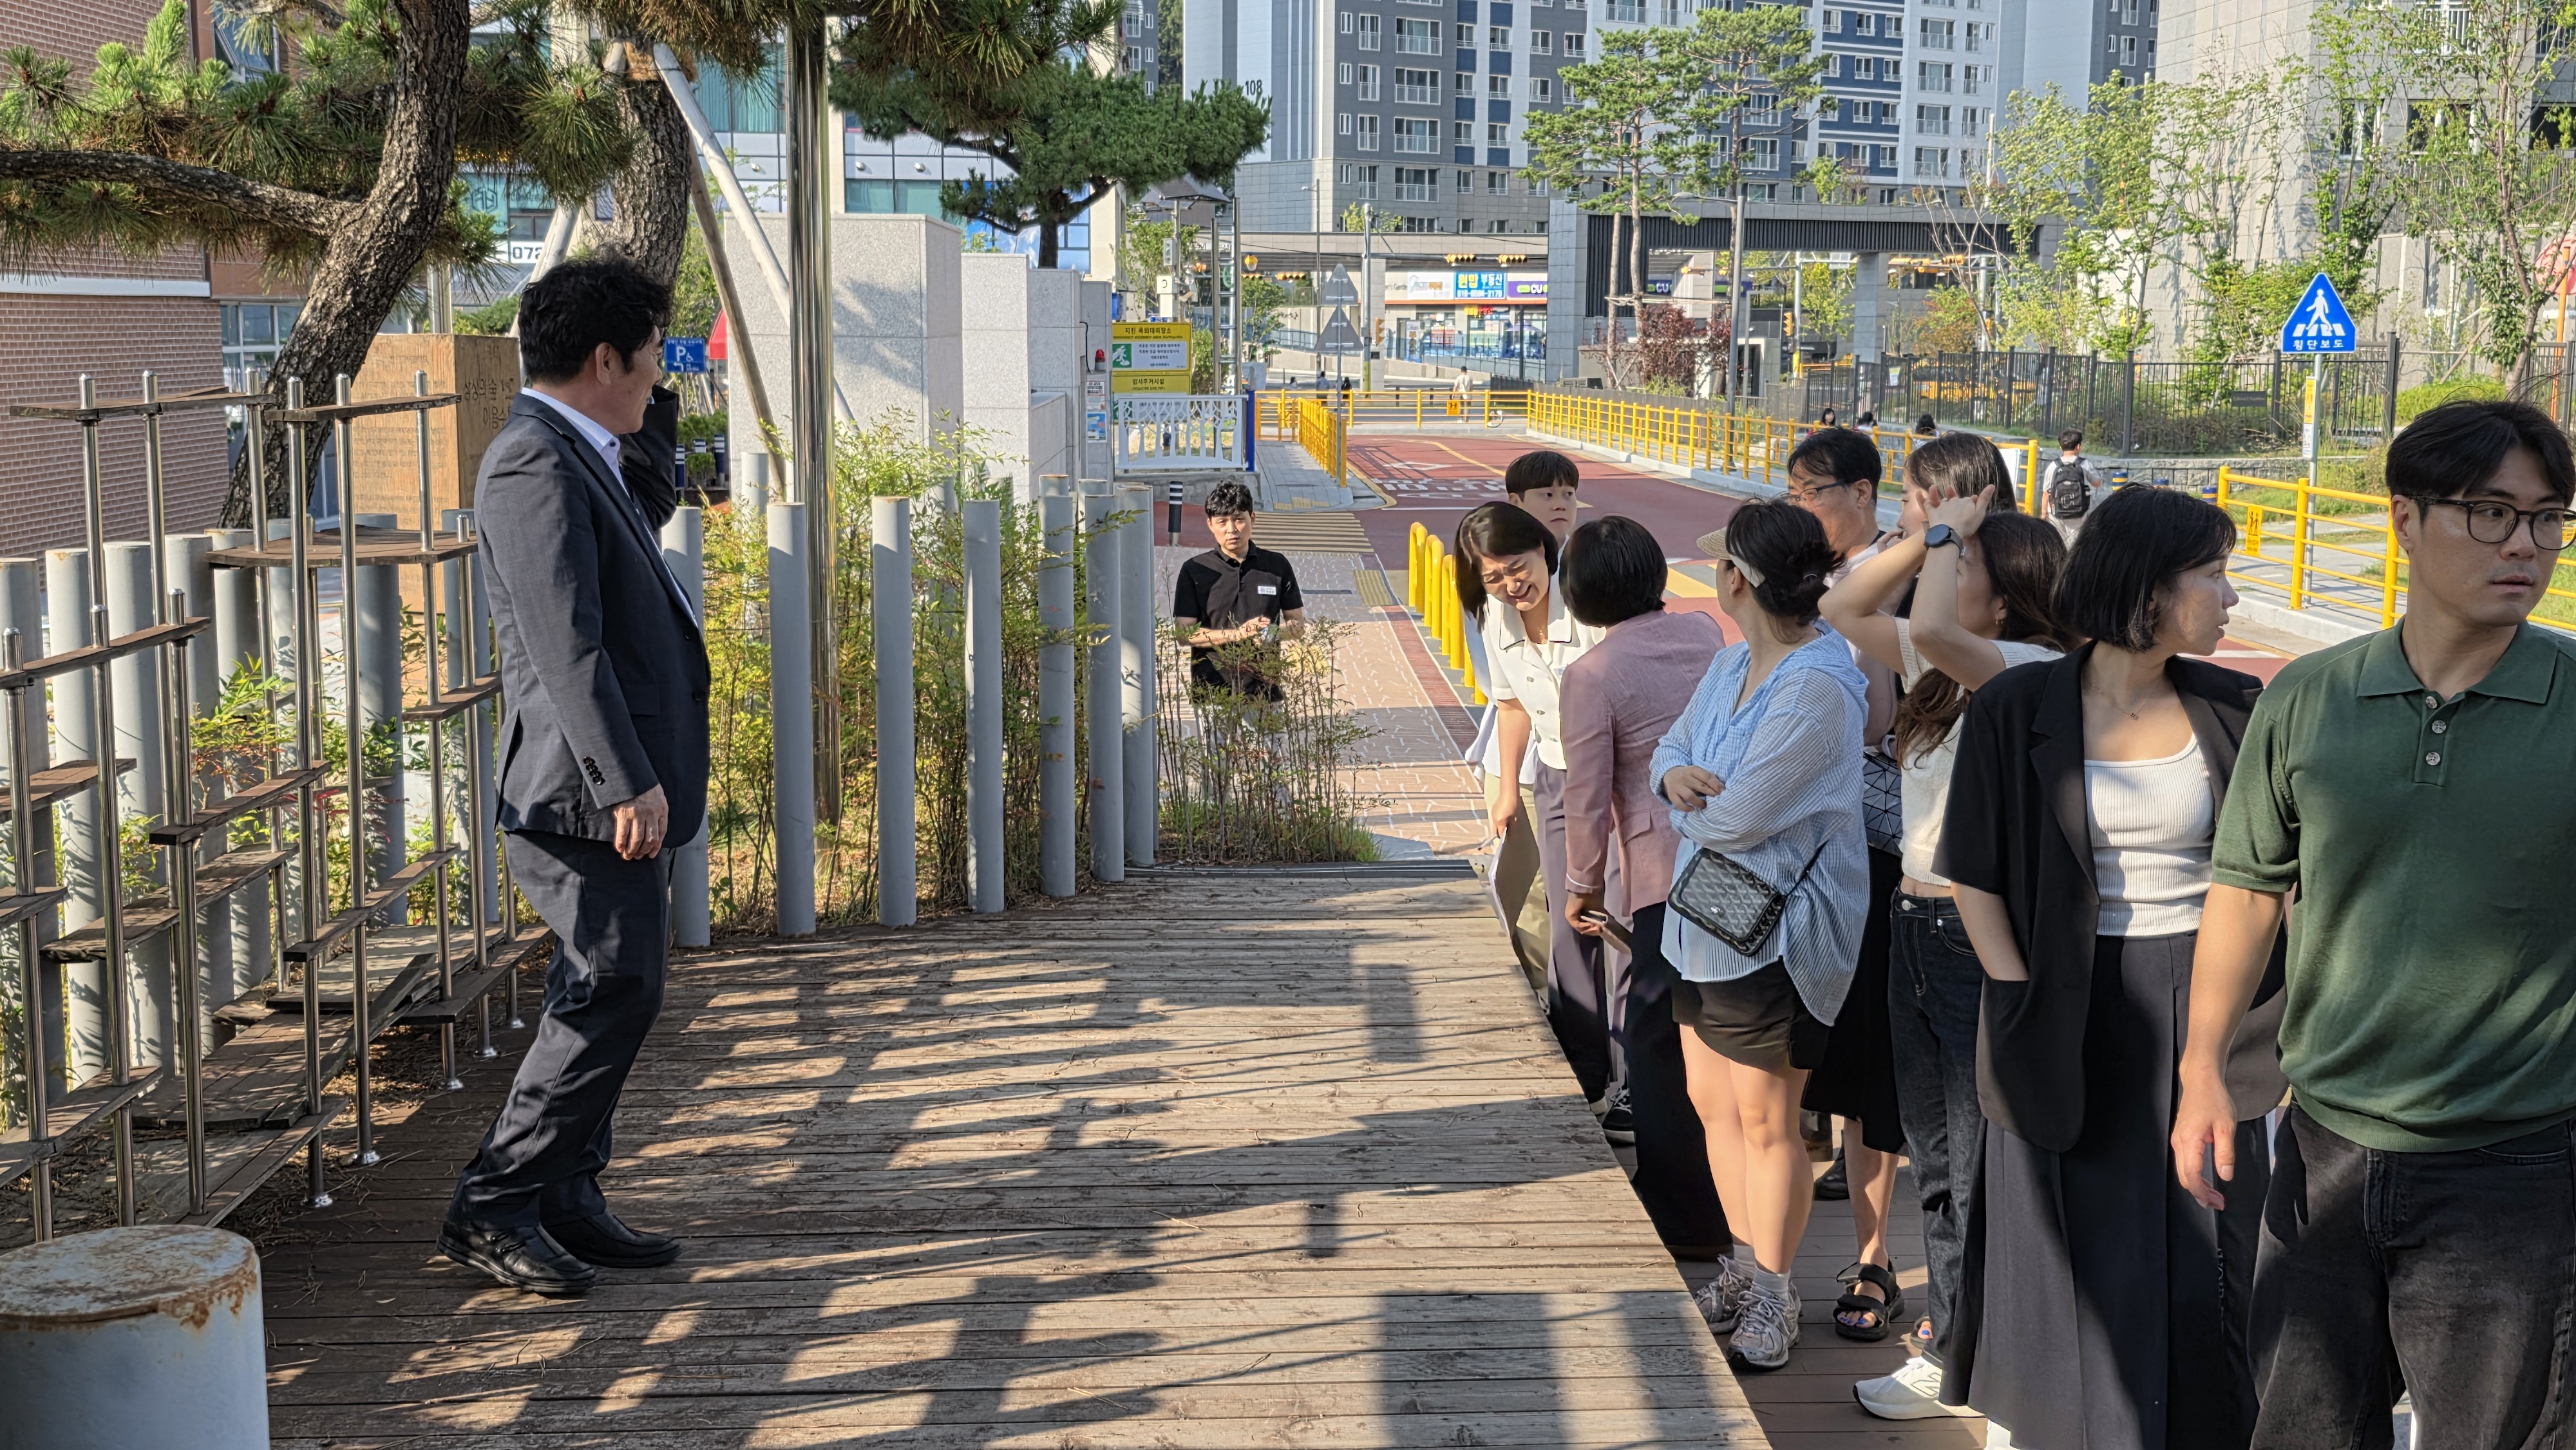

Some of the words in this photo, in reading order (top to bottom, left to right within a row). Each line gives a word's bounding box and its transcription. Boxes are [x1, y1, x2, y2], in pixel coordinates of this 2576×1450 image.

[1245, 79, 1263, 96] 108
[1481, 274, 1502, 286] 부동산
[1531, 284, 1543, 294] CU
[1656, 283, 1669, 293] CU
[2293, 339, 2344, 350] 횡단보도
[676, 346, 686, 361] P
